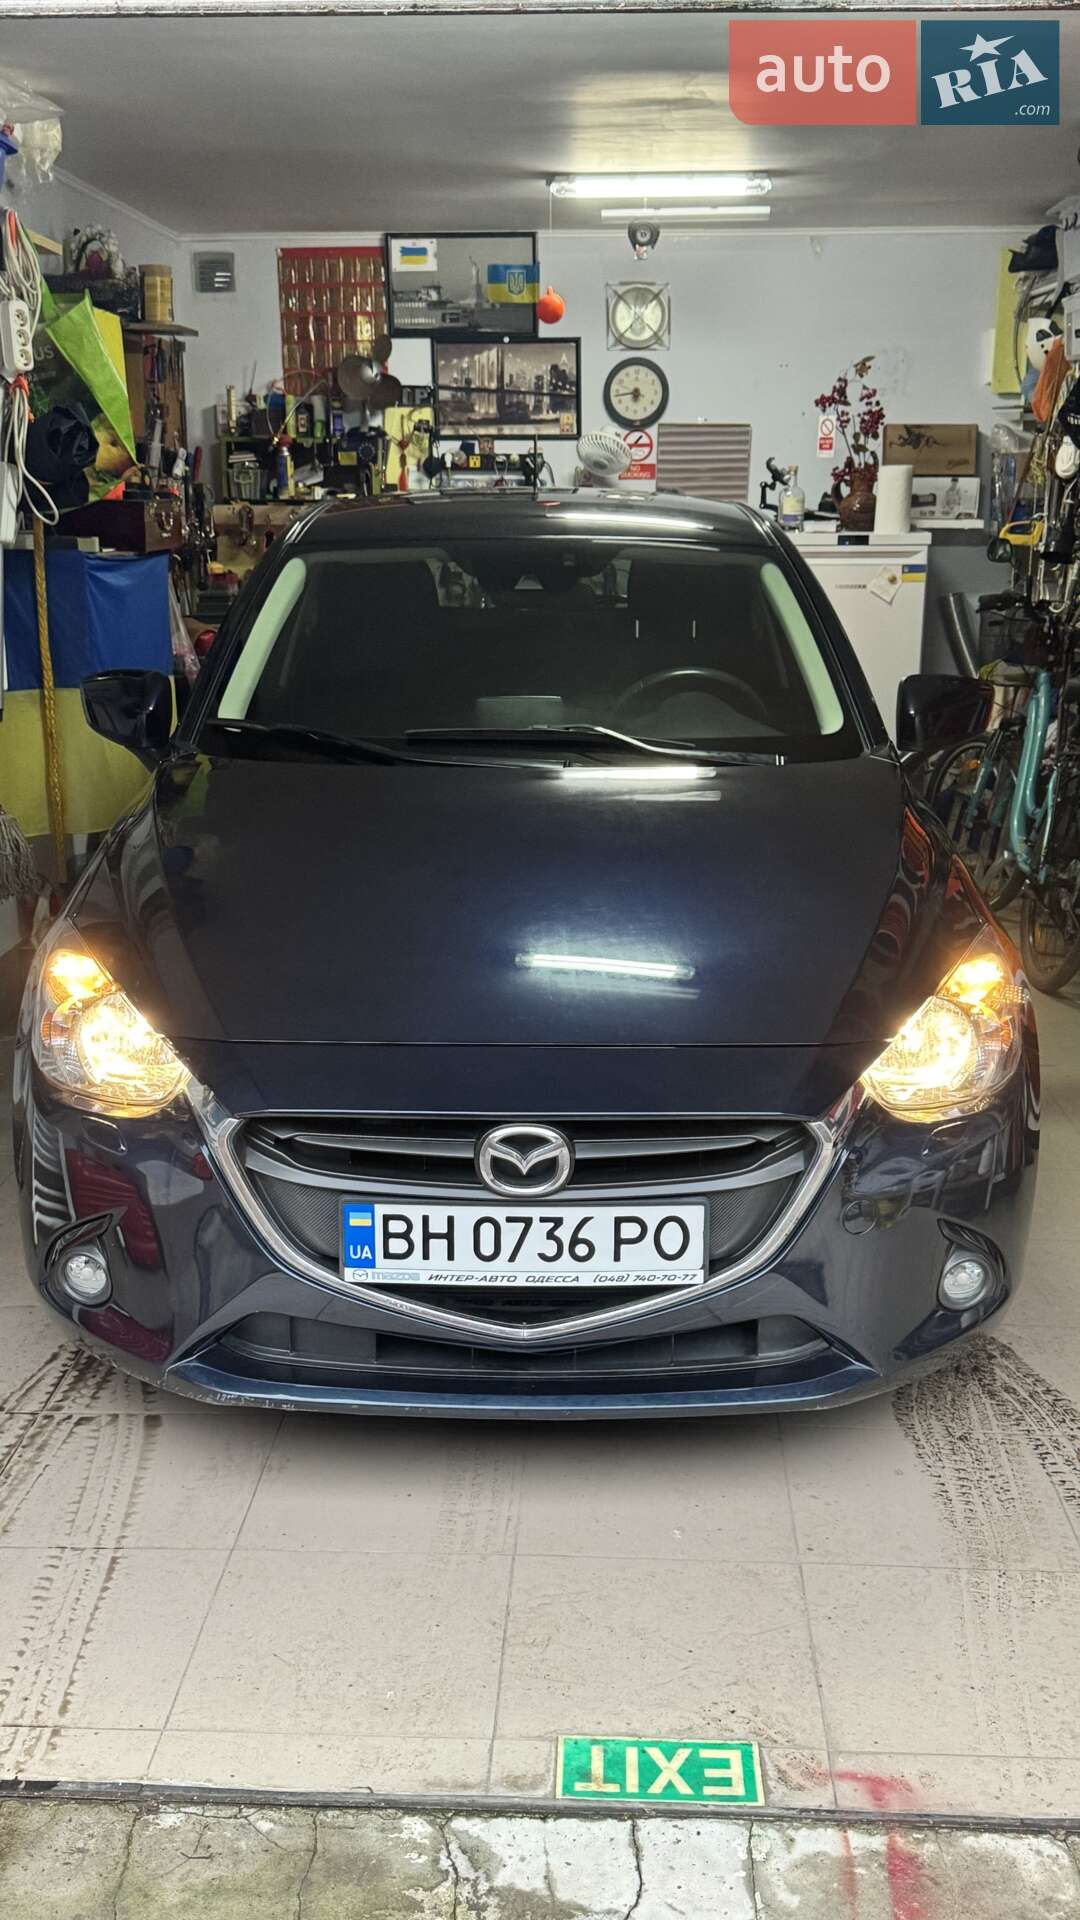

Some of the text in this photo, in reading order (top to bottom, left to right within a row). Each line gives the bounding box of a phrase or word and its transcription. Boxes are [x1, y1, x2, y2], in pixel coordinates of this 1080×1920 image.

[349, 1244, 373, 1260] UA
[382, 1213, 691, 1263] BH 0736 PO
[427, 1273, 698, 1284] ИНТЕР-АВТО ОДЕССА (048) 740-70-77
[574, 1744, 746, 1796] EXIT
